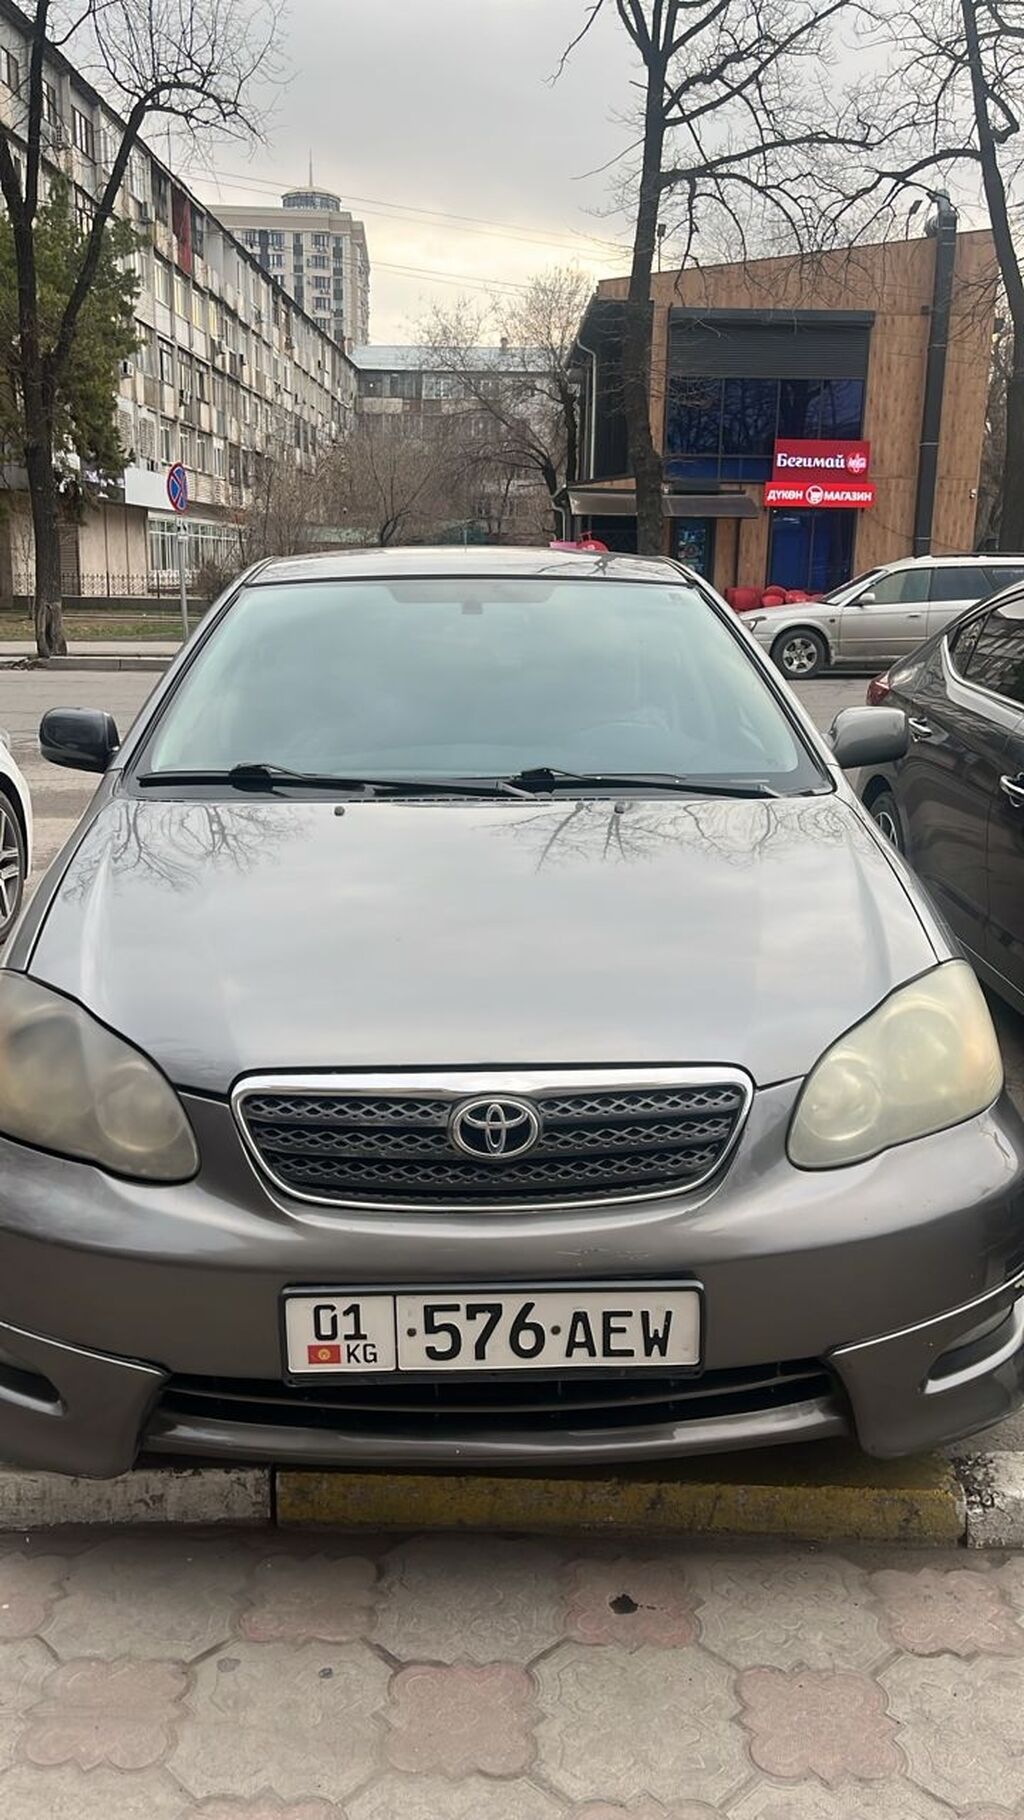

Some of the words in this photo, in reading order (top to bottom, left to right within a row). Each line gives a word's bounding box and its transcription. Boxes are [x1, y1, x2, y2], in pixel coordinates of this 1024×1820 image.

[776, 452, 846, 468] Бегимай
[824, 490, 872, 501] МАГАЗИН
[313, 1304, 368, 1341] 01
[422, 1302, 546, 1362] 576
[565, 1310, 673, 1358] AEW
[346, 1344, 378, 1364] KG
